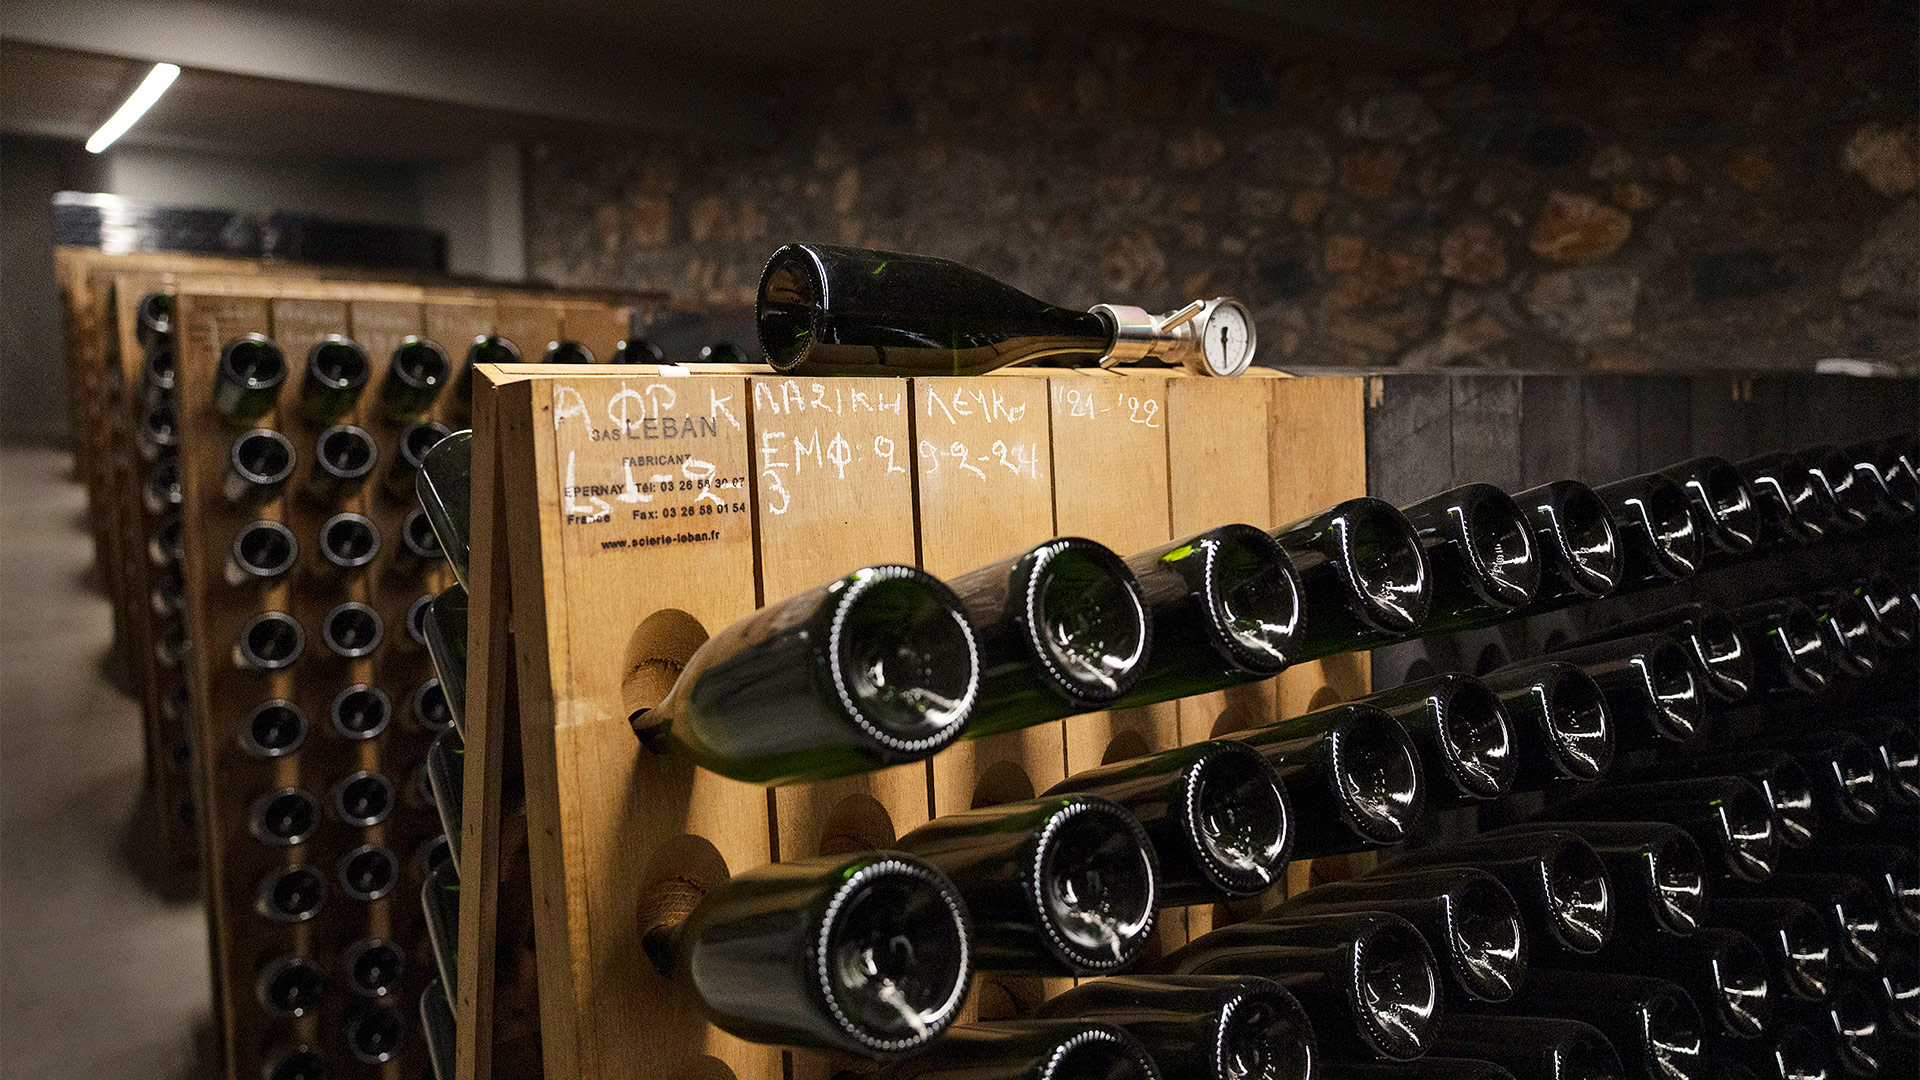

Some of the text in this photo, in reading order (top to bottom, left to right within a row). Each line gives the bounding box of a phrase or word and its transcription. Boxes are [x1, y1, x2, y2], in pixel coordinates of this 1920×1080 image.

[626, 416, 717, 441] LEBAN
[621, 453, 692, 468] FABRICANT
[564, 484, 625, 498] EPERNAY
[660, 481, 675, 492] 03
[679, 480, 693, 491] 26
[697, 478, 711, 490] 58
[632, 509, 658, 521] Fax:
[662, 507, 677, 518] 03
[681, 506, 695, 517] 26
[699, 504, 713, 516] 58
[716, 503, 729, 514] 01
[732, 502, 746, 513] 54
[601, 530, 720, 550] www.scierie-leban.fr
